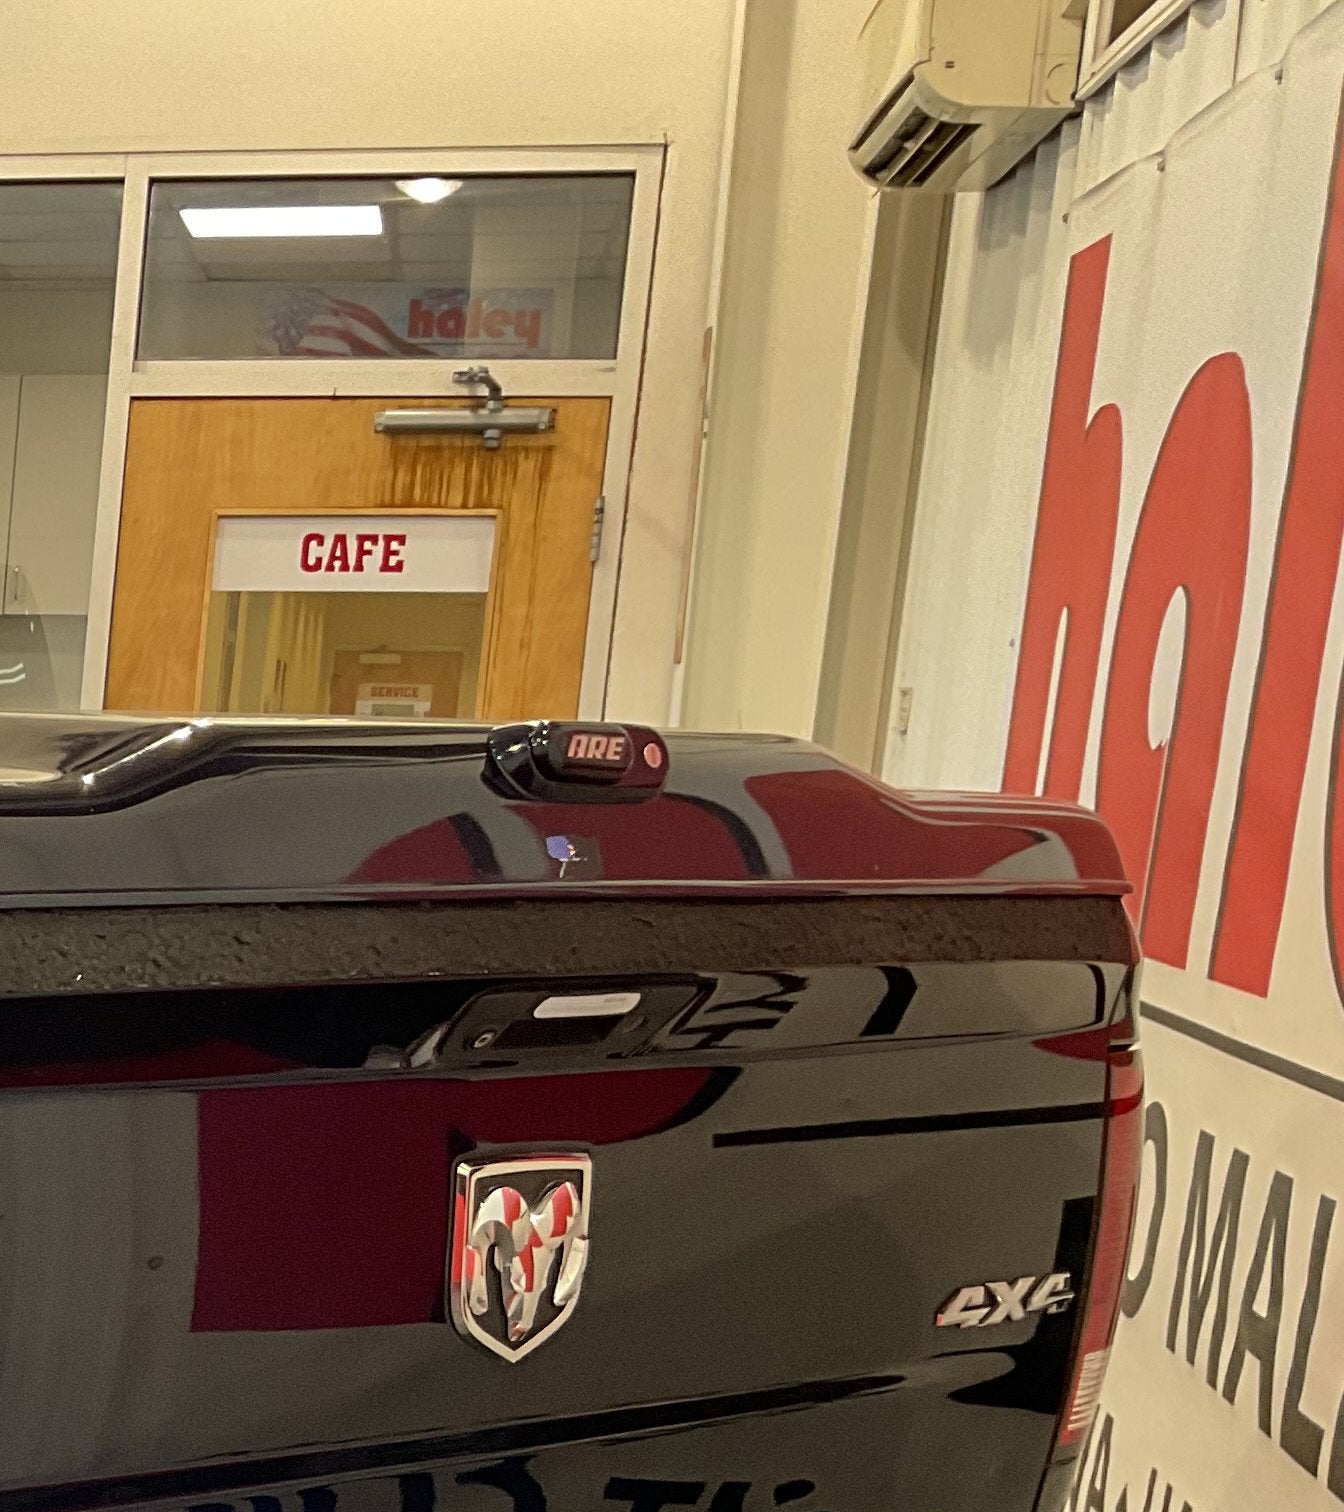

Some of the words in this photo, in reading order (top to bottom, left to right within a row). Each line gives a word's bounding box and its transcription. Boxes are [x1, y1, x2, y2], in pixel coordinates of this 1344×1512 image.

[407, 298, 542, 348] haley
[300, 532, 407, 573] CAFE
[1002, 70, 1344, 1005] hal
[370, 686, 419, 698] SERVICE
[567, 733, 625, 762] ARE
[935, 1271, 1076, 1329] 4X4
[1166, 1128, 1344, 1508] MAL
